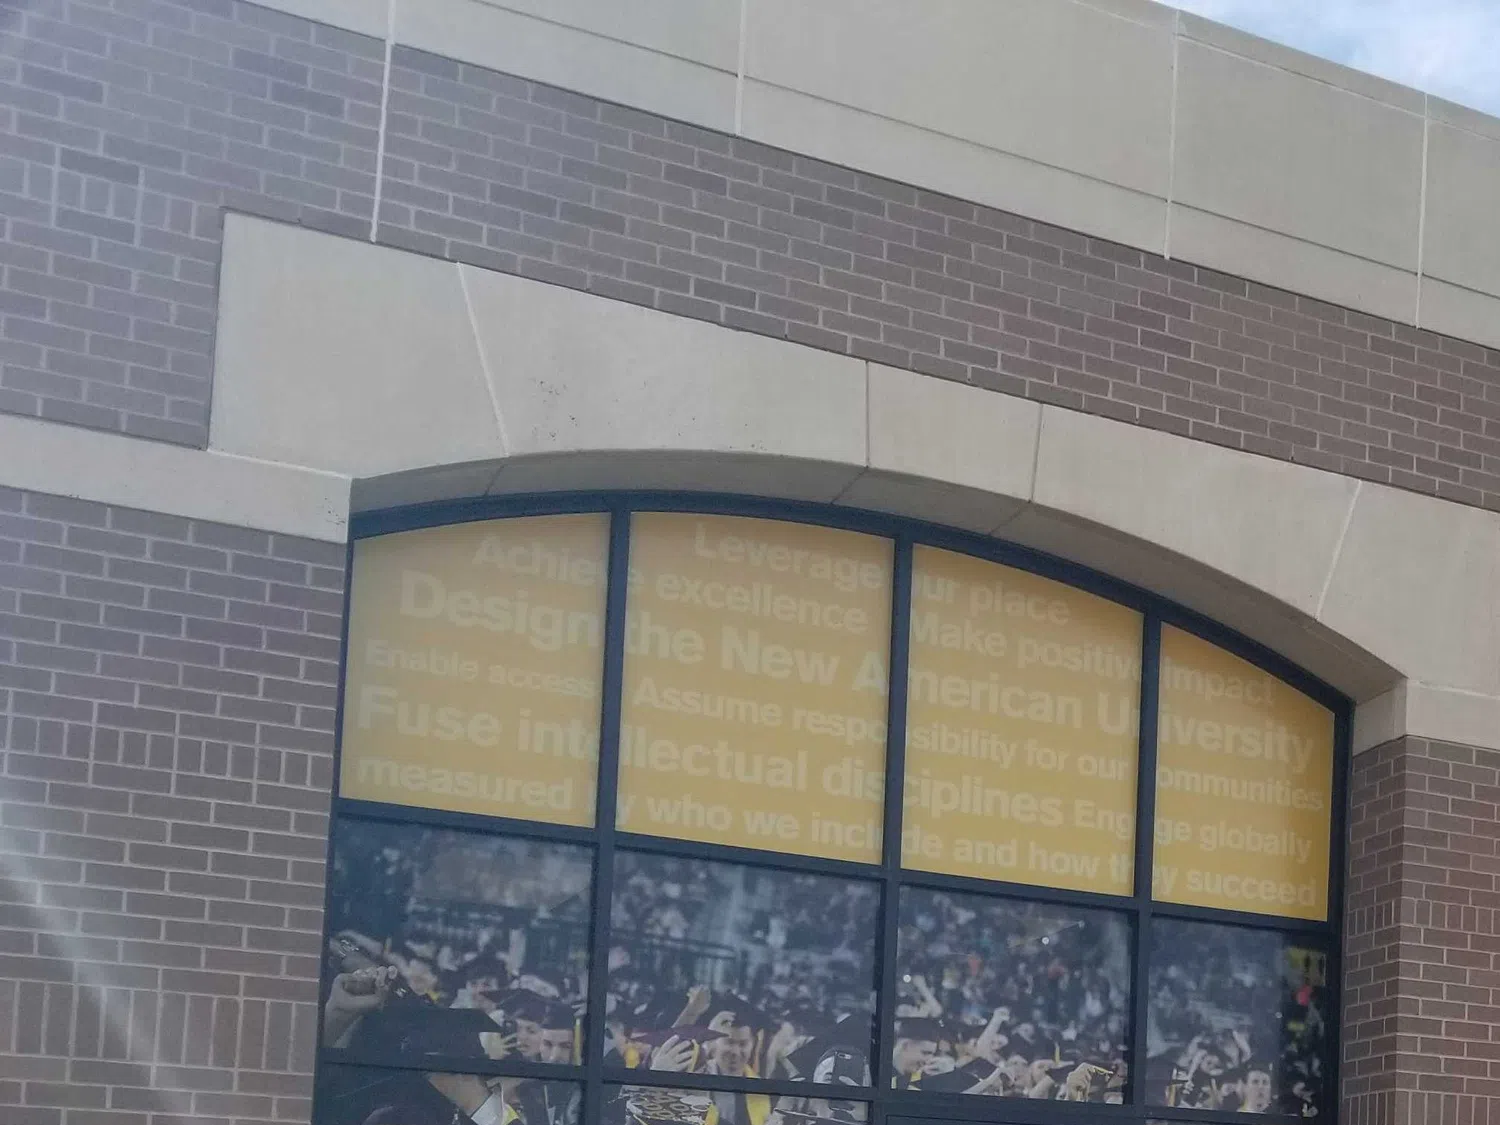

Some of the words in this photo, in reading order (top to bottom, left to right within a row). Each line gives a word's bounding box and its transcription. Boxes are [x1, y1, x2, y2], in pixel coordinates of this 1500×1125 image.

[401, 570, 601, 651] Design
[625, 610, 705, 664] the
[721, 624, 840, 685] New
[471, 532, 646, 593] Achiee
[655, 572, 869, 634] excellence
[911, 608, 1007, 656] Make
[1163, 656, 1273, 704] impact
[694, 522, 883, 592] Leverage
[969, 581, 1069, 625] place
[358, 683, 503, 747] Fuse
[1074, 798, 1192, 847] Engge
[1199, 820, 1313, 864] globally
[365, 638, 479, 681] Enable
[487, 663, 597, 698] access
[632, 676, 783, 727] Assume
[791, 706, 1016, 768] resposibility
[1024, 738, 1069, 771] for
[1077, 753, 1129, 781] our
[1157, 766, 1324, 812] ommunities
[356, 754, 574, 810] measured
[646, 792, 734, 831] who
[743, 809, 801, 841] we
[953, 838, 1018, 868] and
[1029, 841, 1101, 879] how
[1186, 869, 1317, 908] succeed
